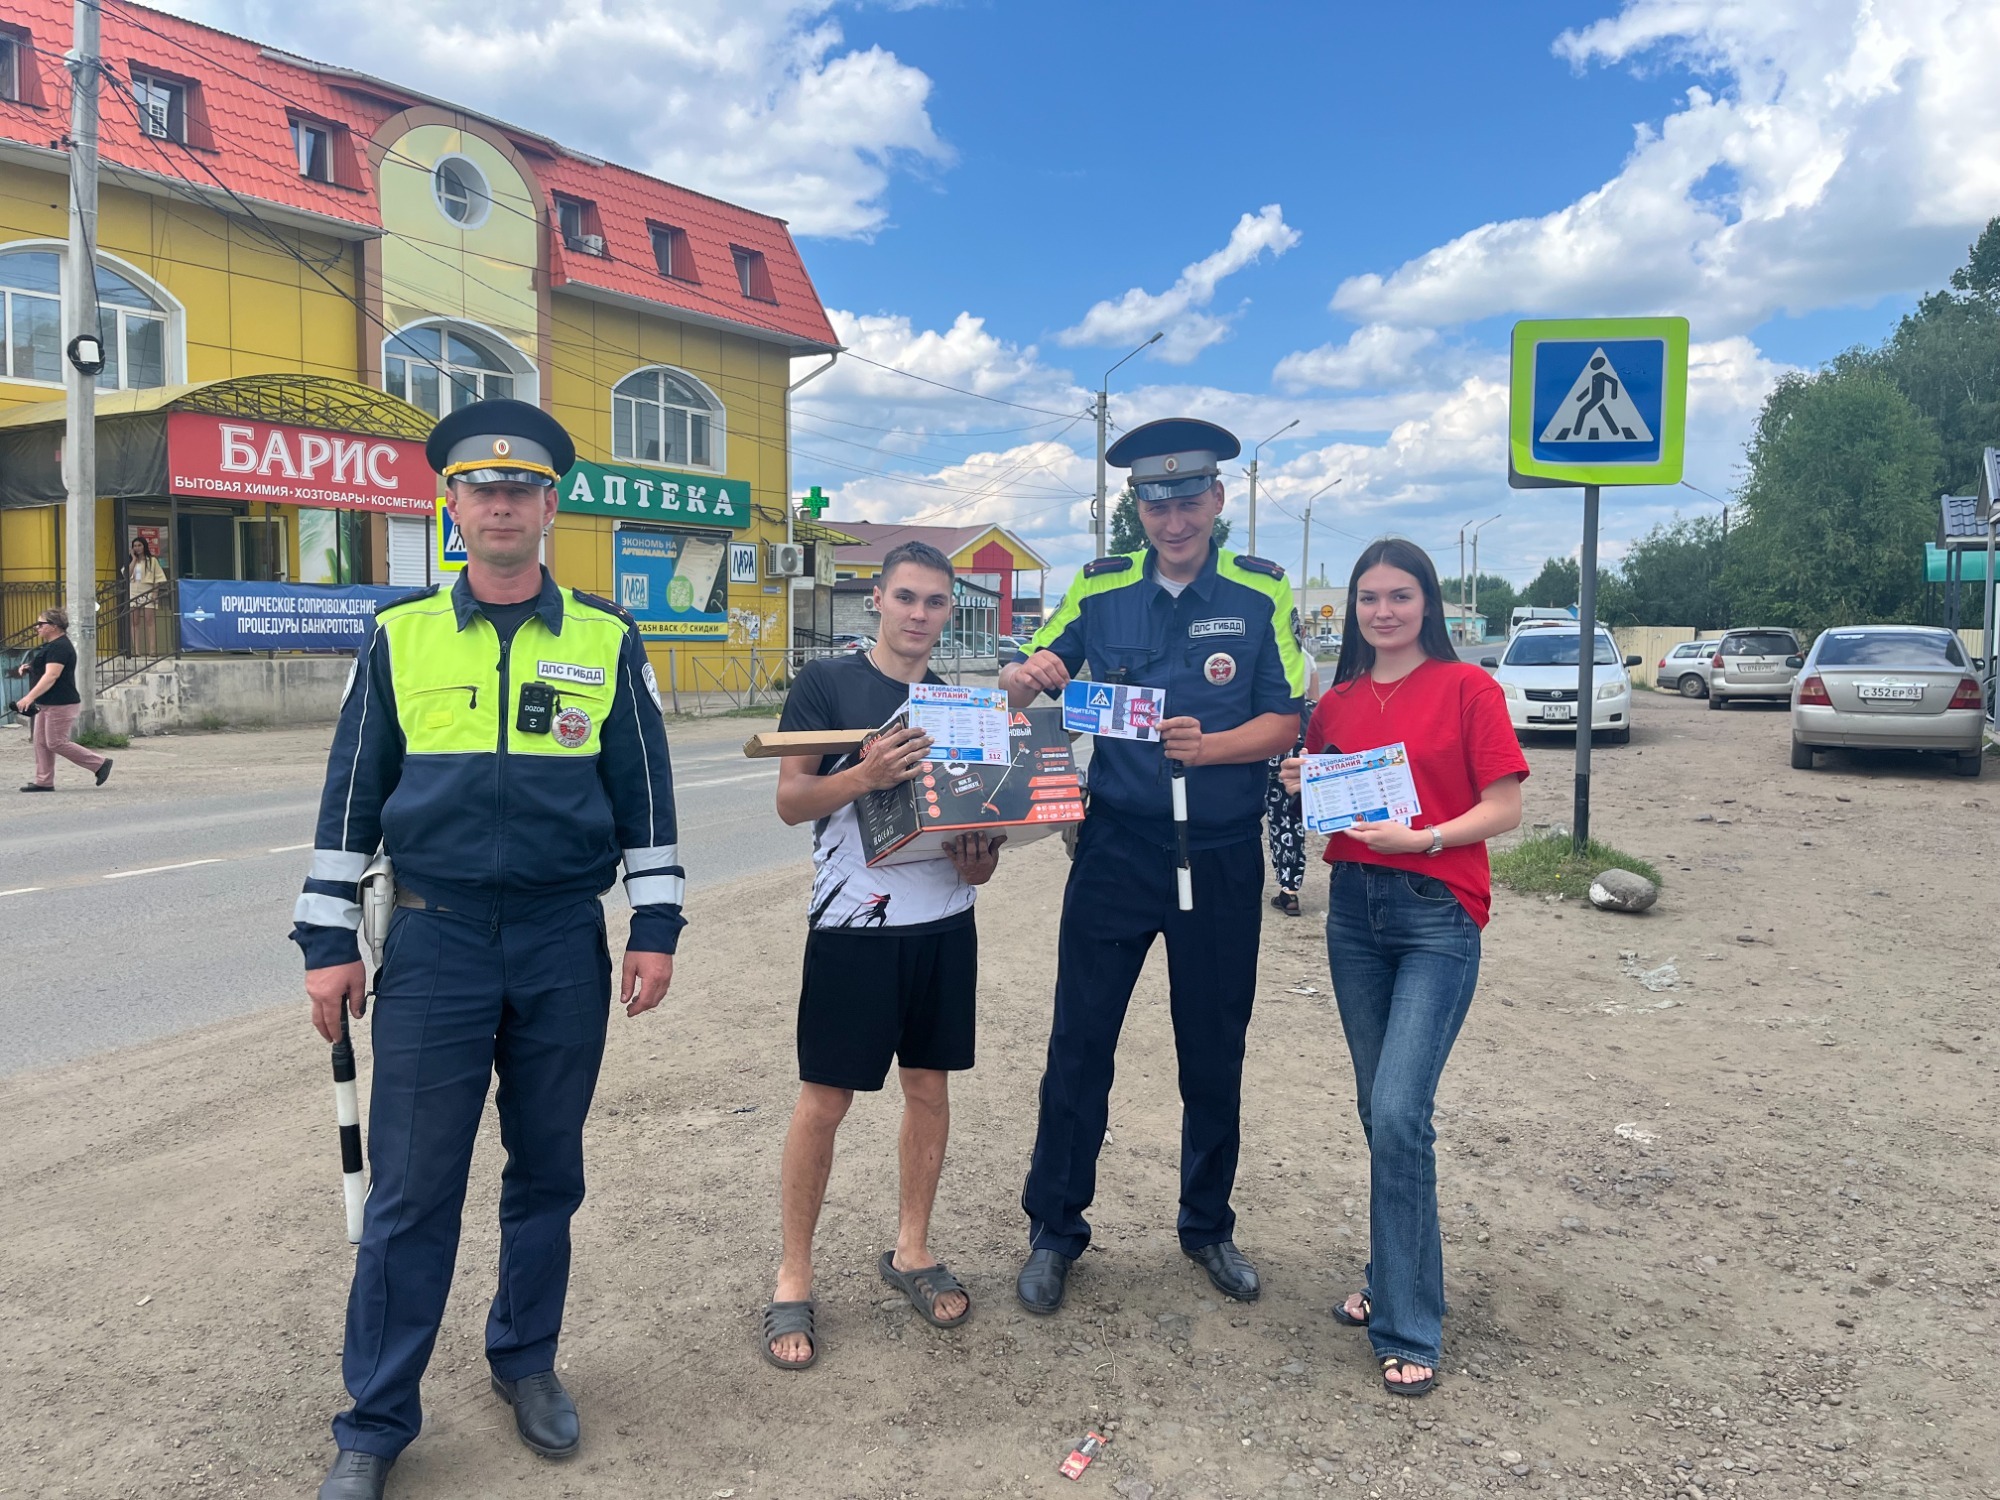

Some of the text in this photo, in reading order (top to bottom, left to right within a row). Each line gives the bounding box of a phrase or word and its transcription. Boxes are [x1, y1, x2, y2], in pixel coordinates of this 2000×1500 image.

[219, 423, 399, 489] БАРИС
[175, 476, 434, 510] БЫТОВАЯ ХИМИЯ ХОЗТОВАРЫ КОСМЕТИКА
[568, 472, 735, 516] АПТЕКА
[622, 538, 677, 550] ЭКОНОМЬ НА
[221, 595, 377, 616] ЮРИДИЧЕСКОЕ СОПРОВОЖДЕНИЕ
[237, 616, 365, 635] ПРОЦЕДУРЫ БАНКРОТСТВА
[638, 624, 658, 632] CASH
[689, 625, 719, 634] СКИДКИ
[1194, 622, 1242, 633] ДПС ГИБДД
[541, 664, 602, 681] ДПС ГИБДД
[524, 704, 545, 713] DOZOR
[1008, 727, 1032, 737] НОВЫЙ
[1325, 760, 1362, 773] КУПАНИЯ
[1394, 807, 1409, 816] 112
